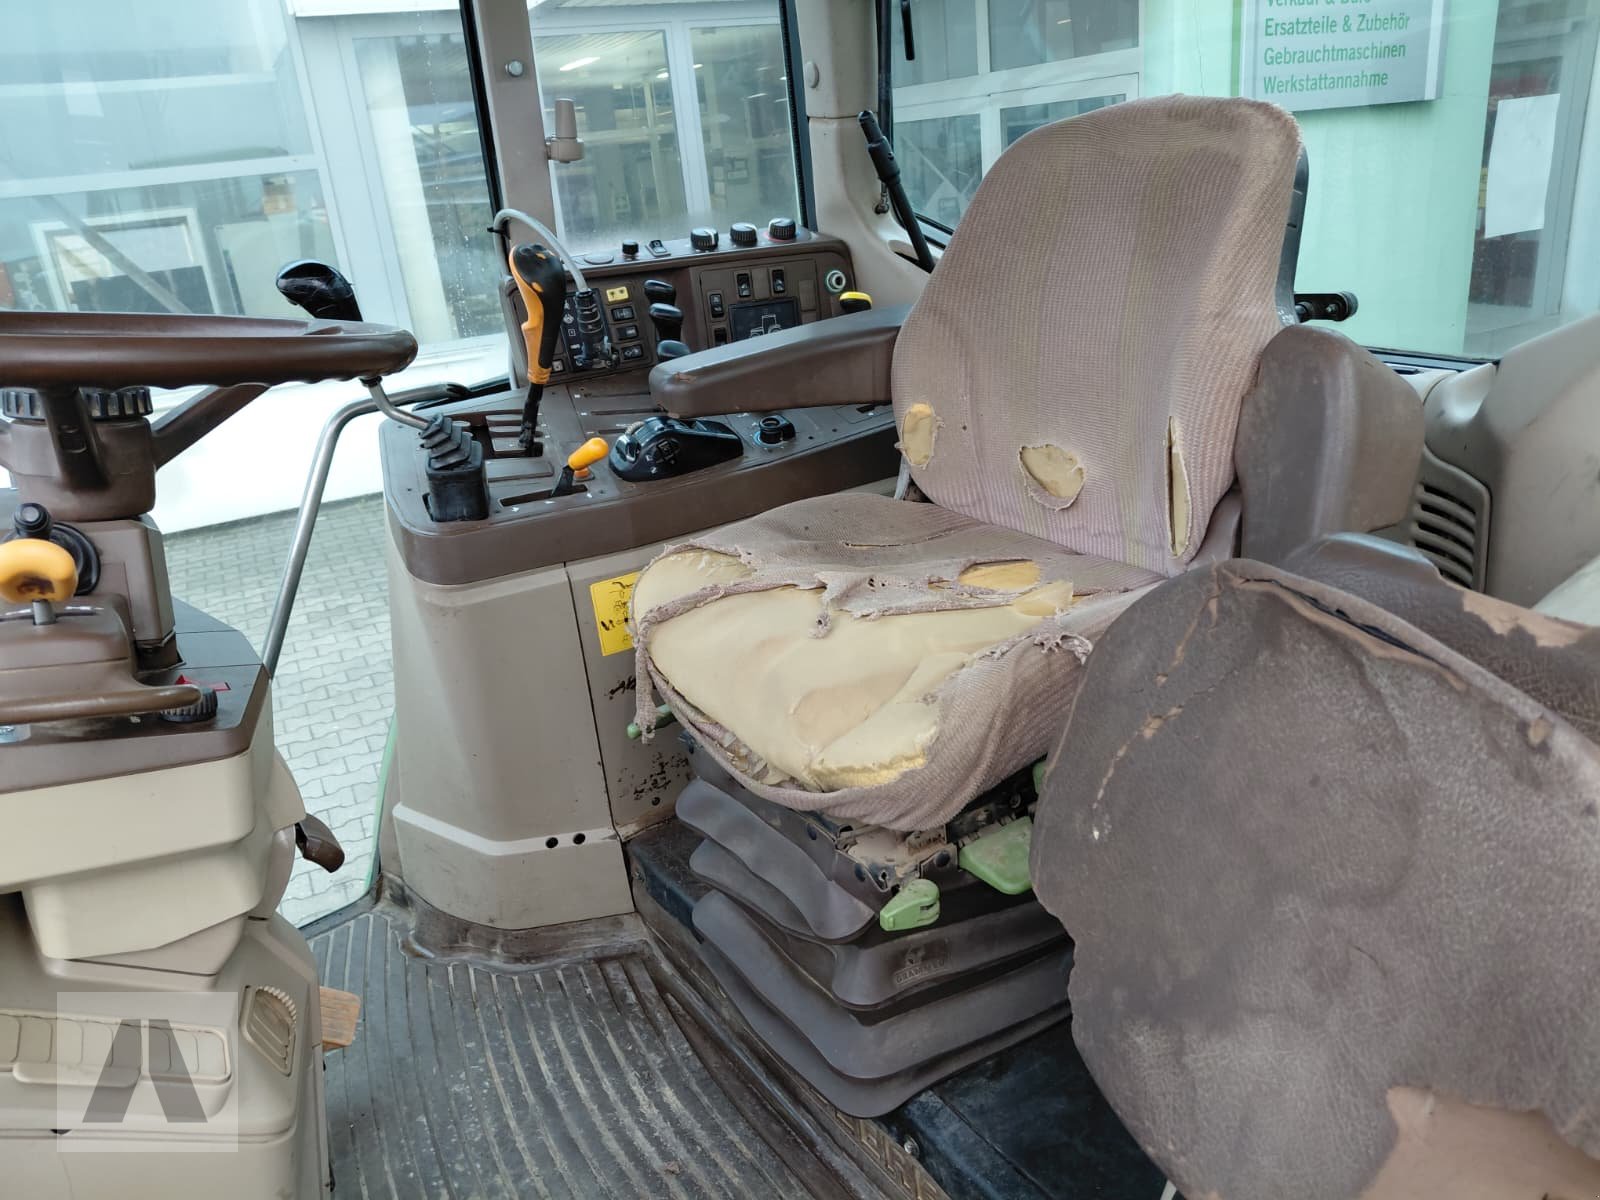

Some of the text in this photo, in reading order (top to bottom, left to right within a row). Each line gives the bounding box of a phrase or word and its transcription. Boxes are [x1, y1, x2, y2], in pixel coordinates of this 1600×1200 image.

[1264, 12, 1410, 36] Ersatzteile & Zubehör
[1264, 41, 1406, 65] Gebrauchtmaschinen
[1263, 70, 1388, 94] Werkstattannahme
